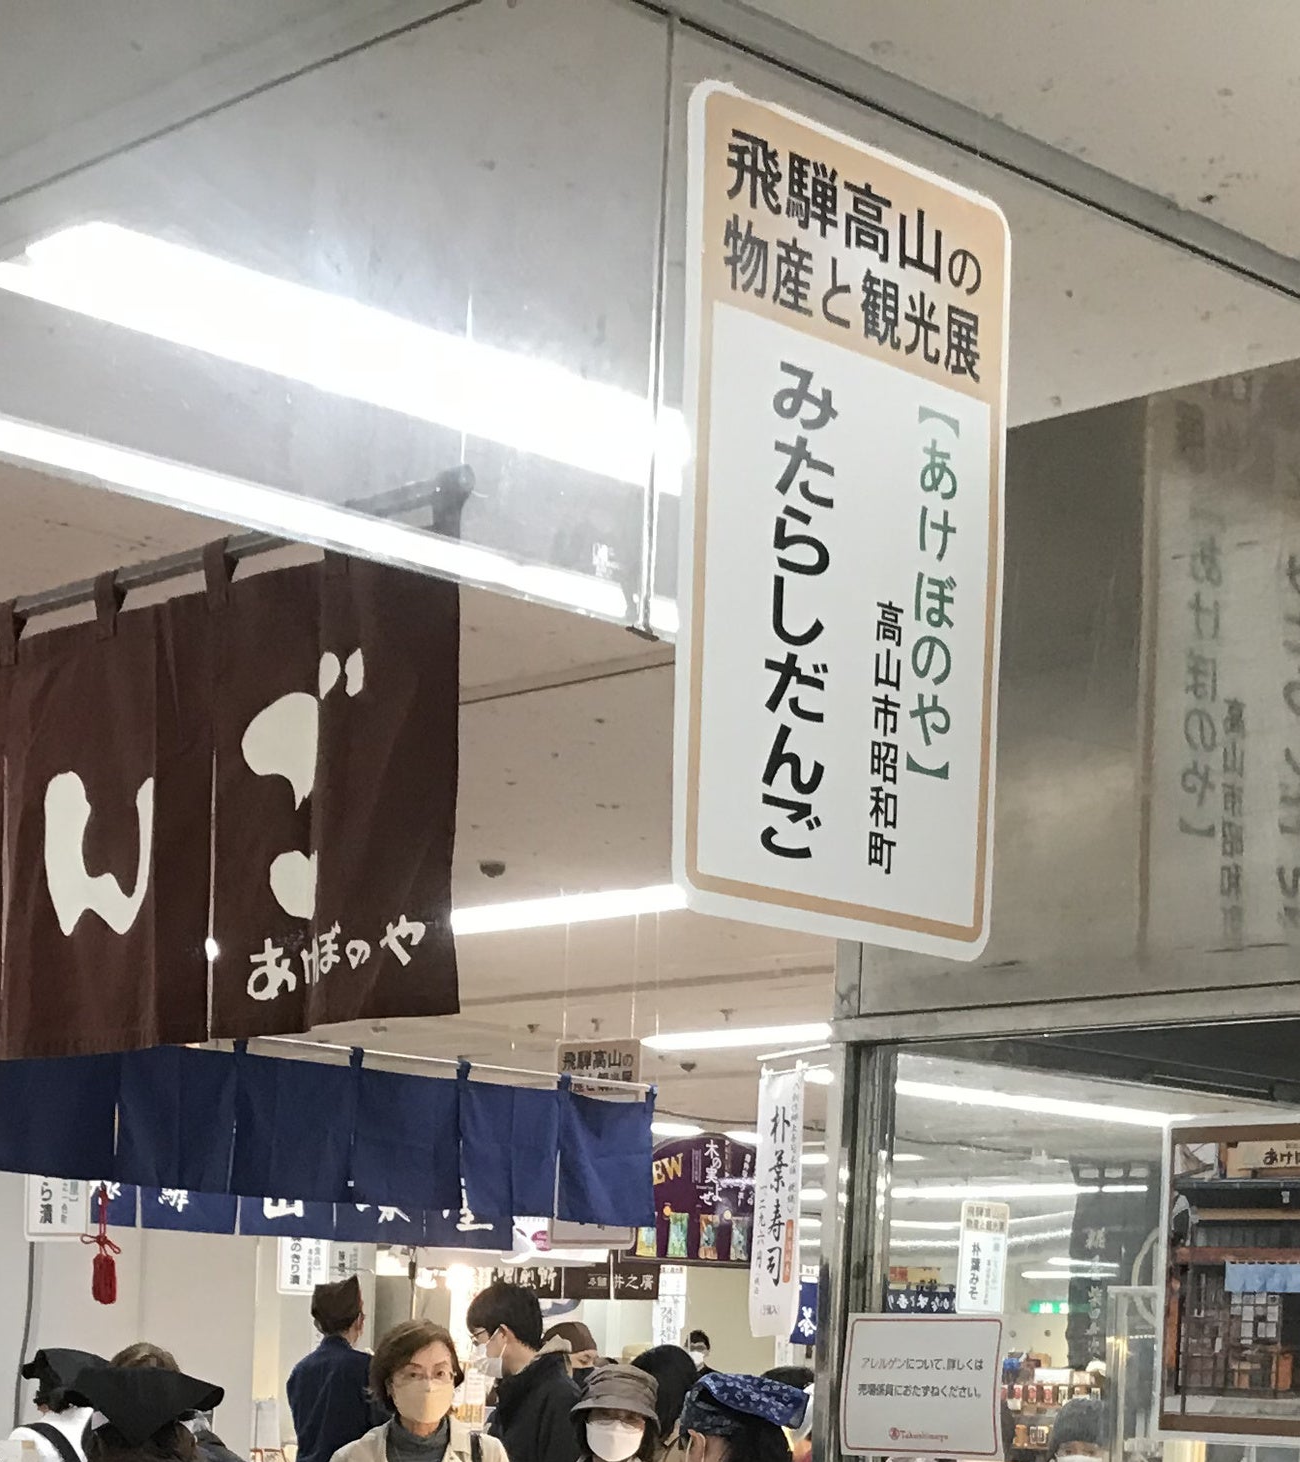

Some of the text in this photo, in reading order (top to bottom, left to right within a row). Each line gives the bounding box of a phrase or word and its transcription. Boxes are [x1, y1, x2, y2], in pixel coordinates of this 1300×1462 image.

[726, 128, 982, 295] 飛騨高山の
[723, 219, 981, 384] 物産と観光展
[760, 362, 839, 859] みたらしだんご
[867, 601, 904, 874] 高山市昭和町
[563, 1050, 634, 1071] 飛騨高山の
